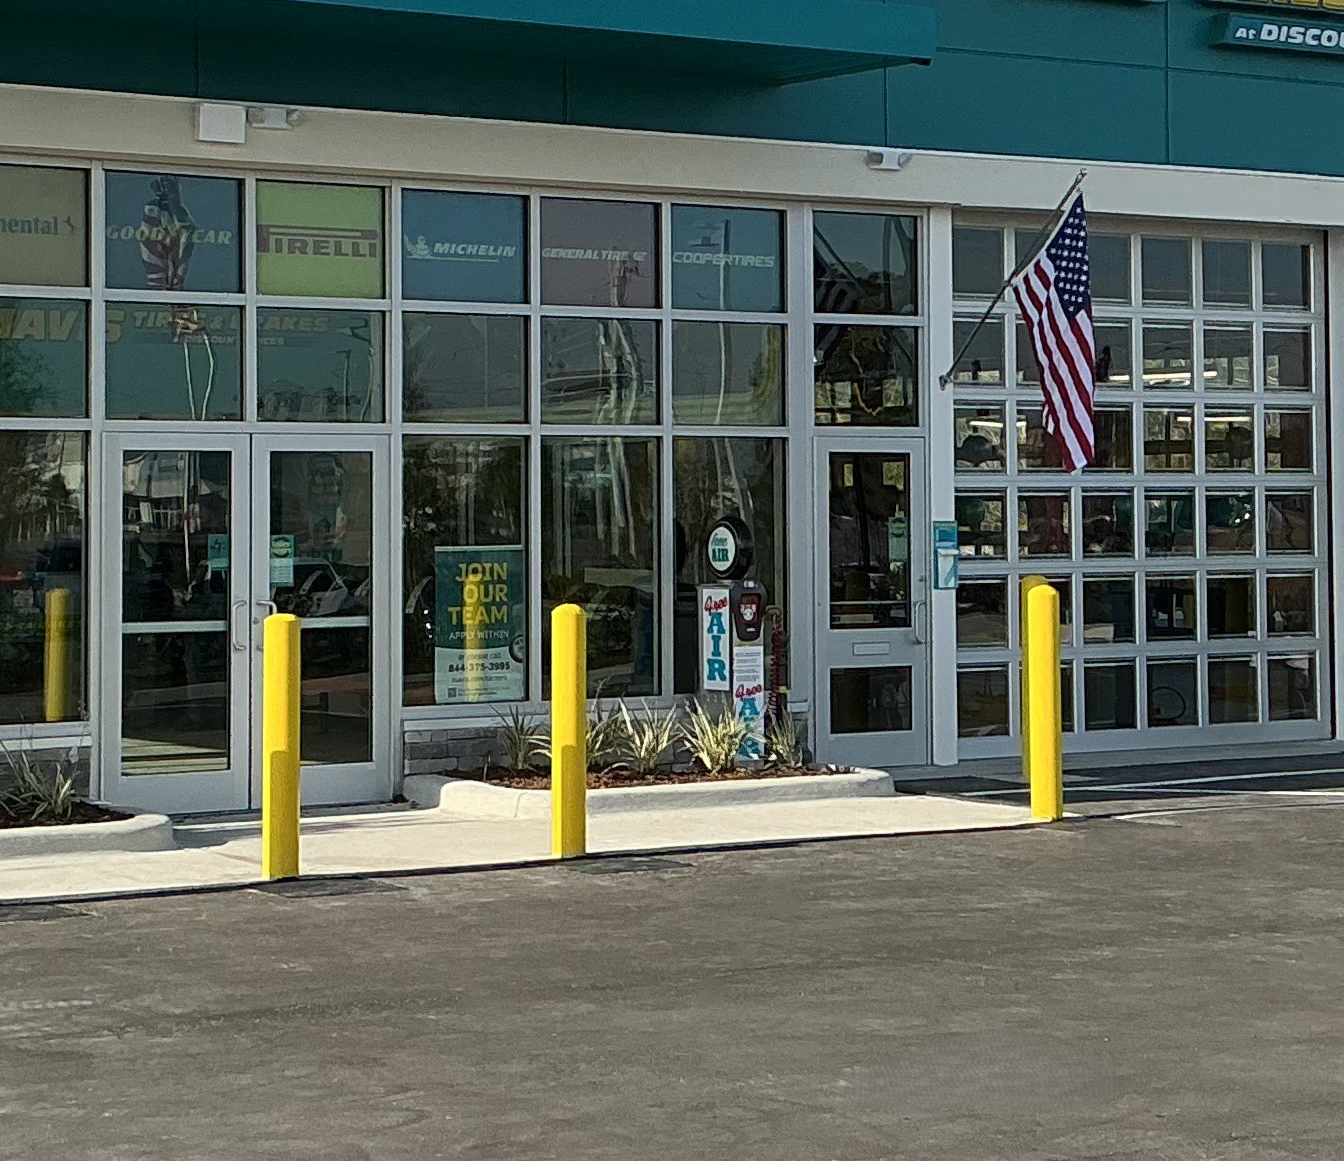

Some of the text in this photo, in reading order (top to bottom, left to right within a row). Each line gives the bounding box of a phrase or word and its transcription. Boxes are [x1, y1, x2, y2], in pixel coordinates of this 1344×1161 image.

[257, 224, 377, 258] PIRELLI
[433, 242, 517, 257] MICHELIN
[712, 548, 730, 563] AIR
[455, 562, 508, 582] JOIN
[463, 584, 508, 603] OUR
[447, 605, 508, 626] TEAM
[706, 612, 727, 681] AIR
